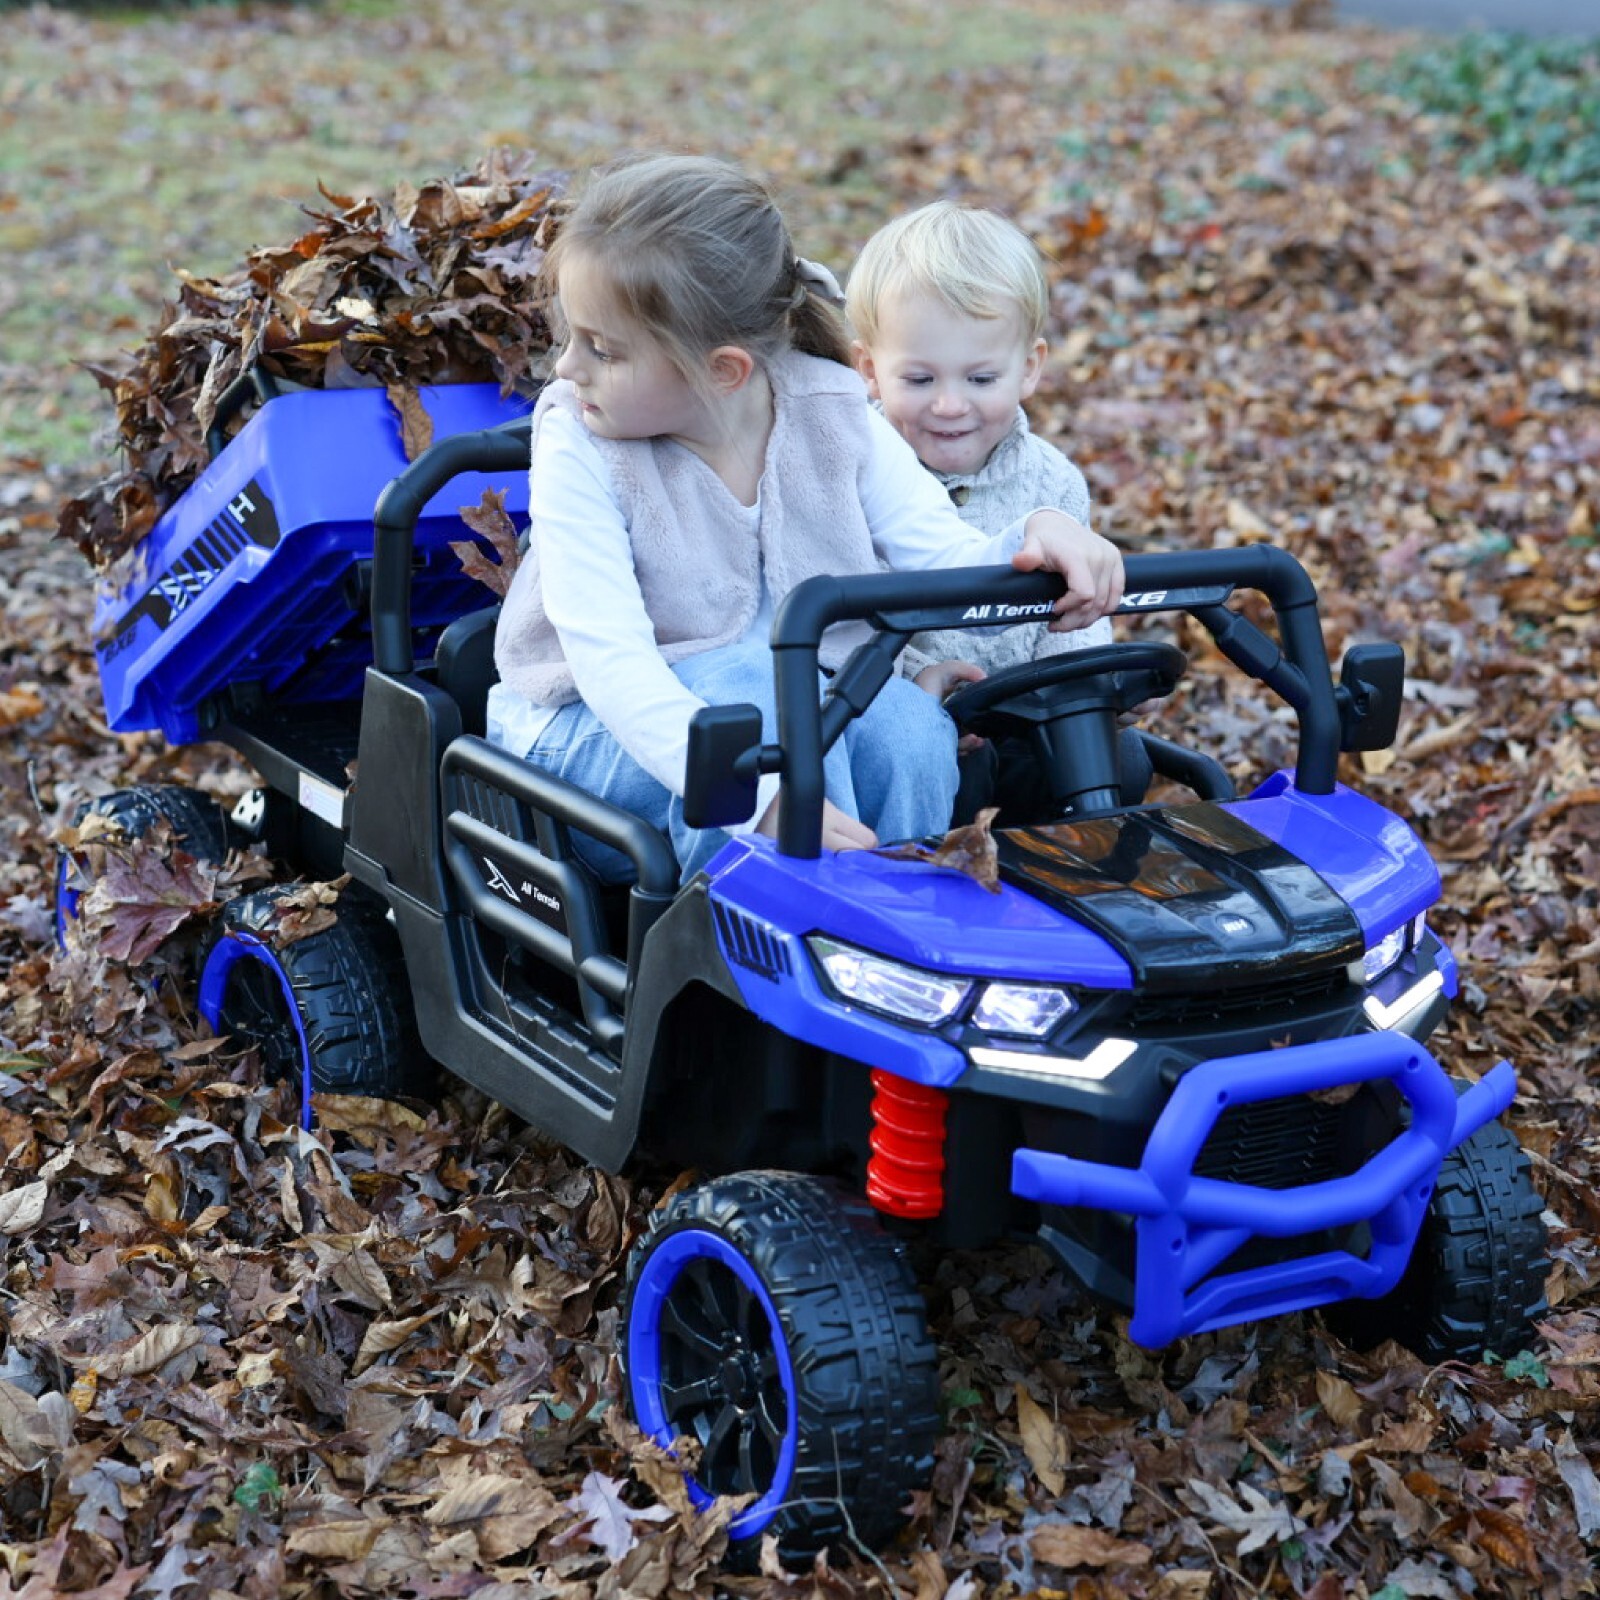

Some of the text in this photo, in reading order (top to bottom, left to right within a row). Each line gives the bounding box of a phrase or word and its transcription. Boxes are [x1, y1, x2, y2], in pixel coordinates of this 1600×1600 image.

[228, 492, 256, 523] H
[962, 600, 1055, 620] All Terrai
[521, 881, 560, 912] All Terrain
